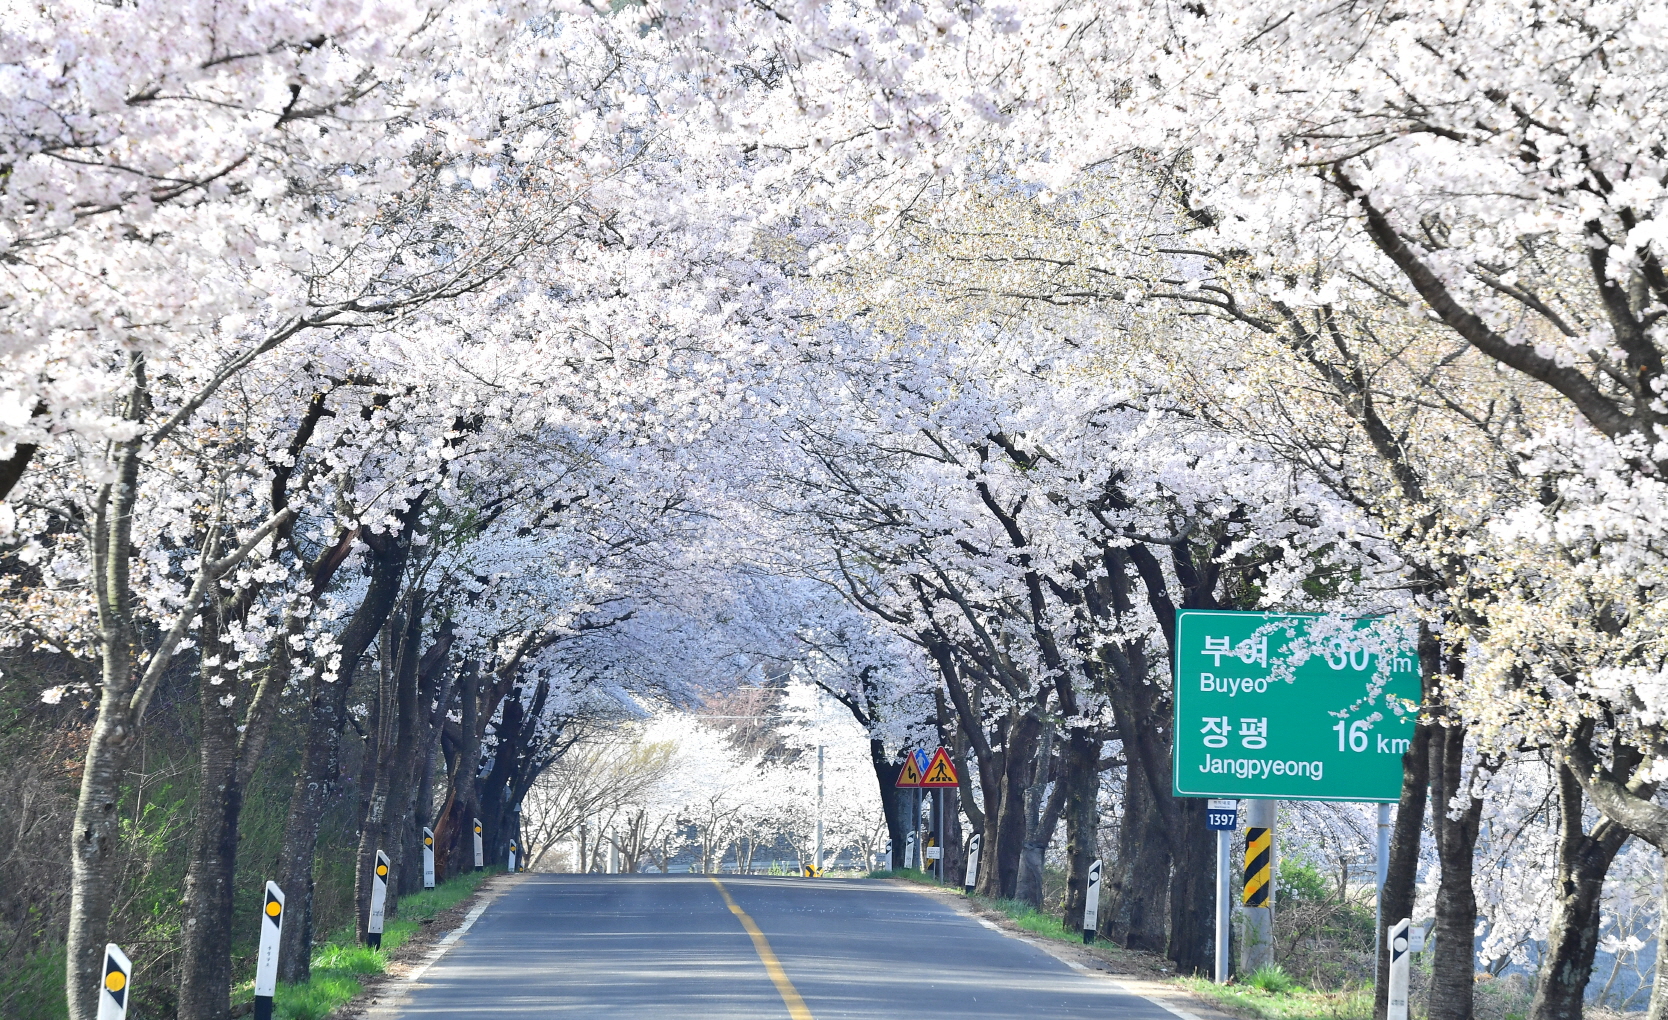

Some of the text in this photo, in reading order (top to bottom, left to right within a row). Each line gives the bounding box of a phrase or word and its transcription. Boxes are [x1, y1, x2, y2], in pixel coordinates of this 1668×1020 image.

[1200, 635, 1268, 668] 부여
[1200, 672, 1268, 698] Buyeo
[1200, 716, 1411, 754] 장평 16 km
[1199, 753, 1323, 780] Jangpyeong
[1208, 813, 1235, 826] 1397
